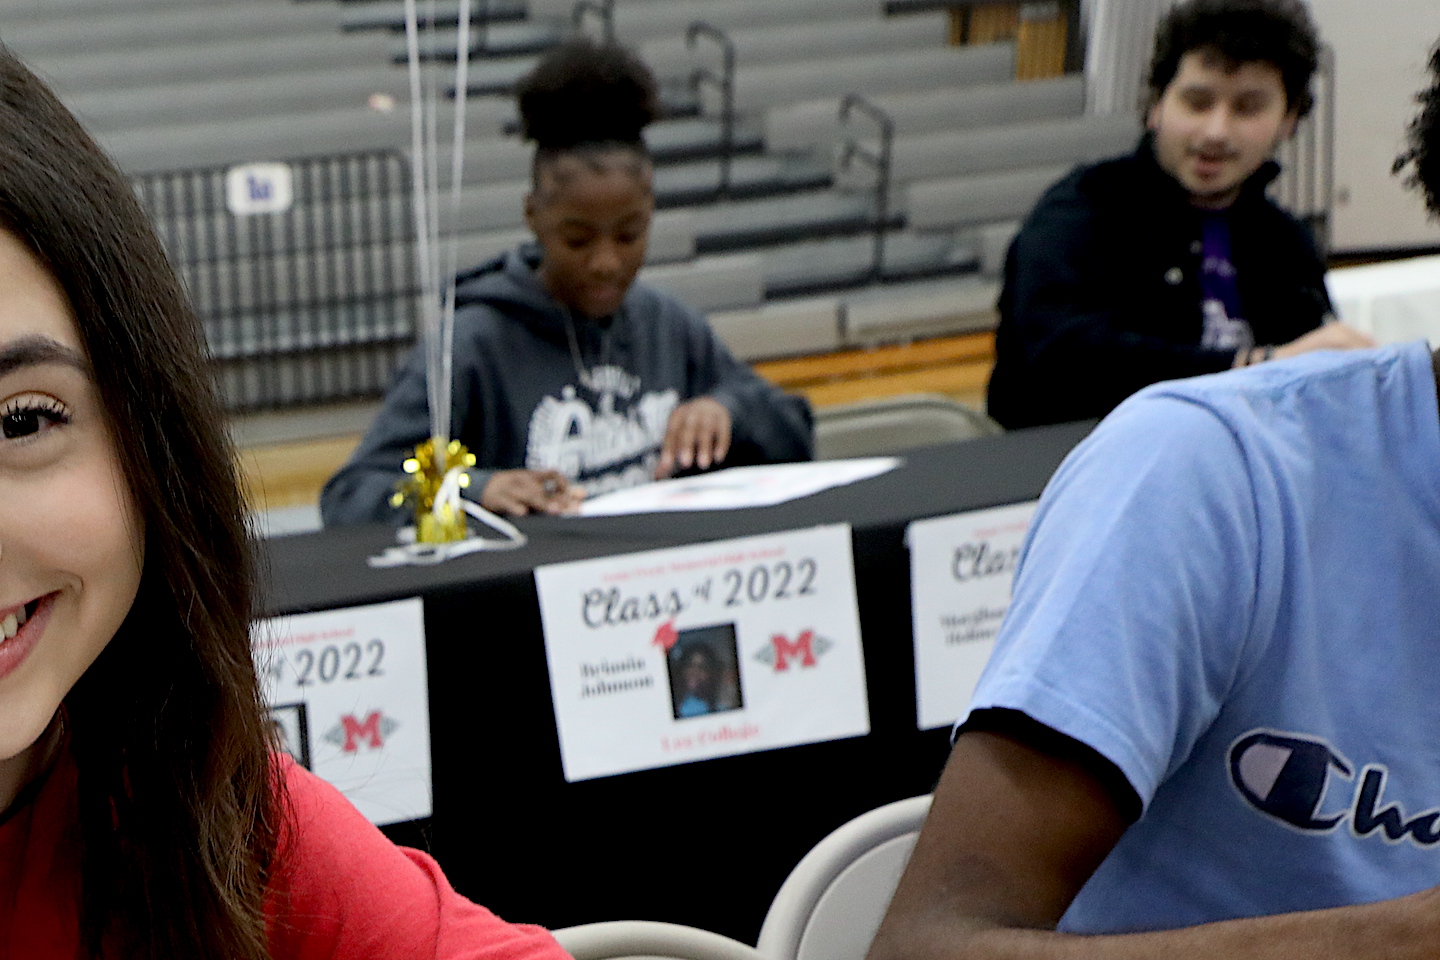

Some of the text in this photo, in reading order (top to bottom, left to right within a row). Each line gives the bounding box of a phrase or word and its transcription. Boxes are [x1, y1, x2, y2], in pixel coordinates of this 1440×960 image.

[580, 585, 686, 628] Class
[722, 556, 818, 607] 2022
[295, 637, 386, 687] 2022
[771, 628, 817, 672] M
[340, 710, 384, 753] M
